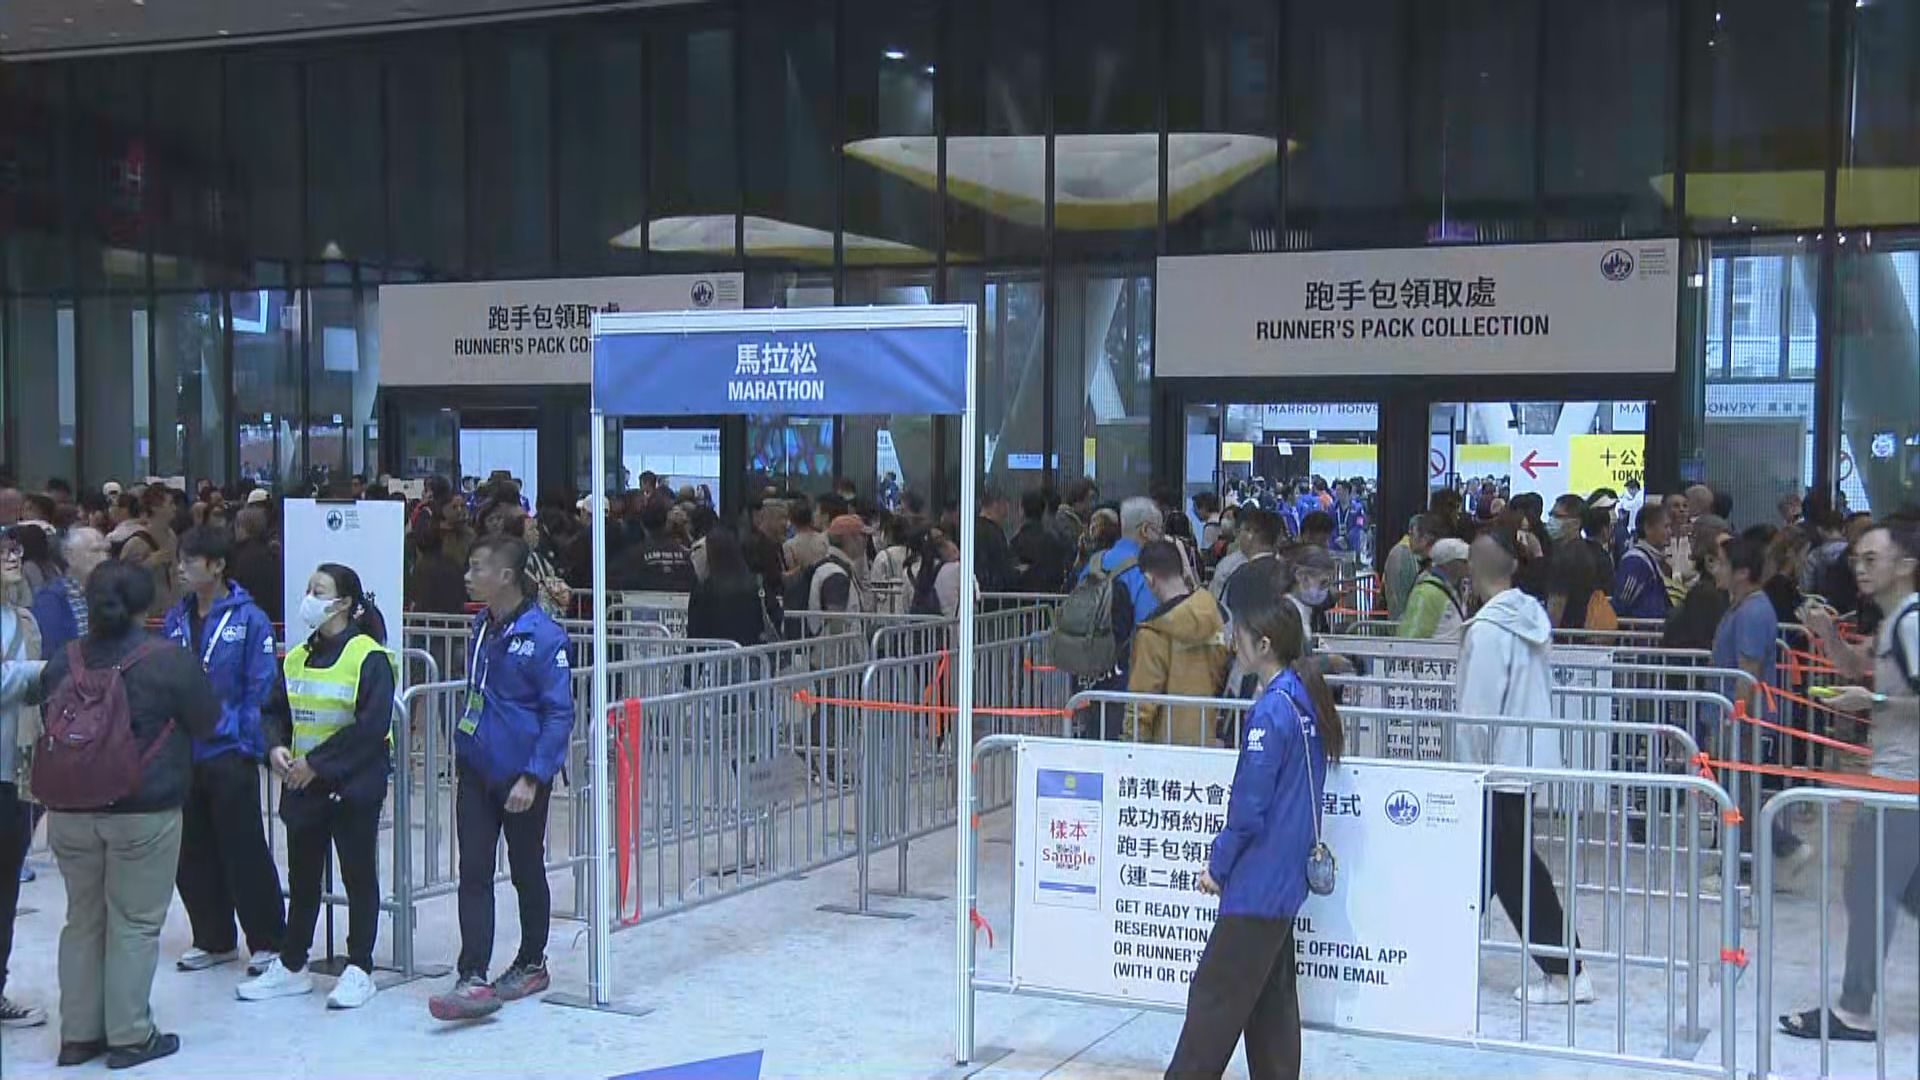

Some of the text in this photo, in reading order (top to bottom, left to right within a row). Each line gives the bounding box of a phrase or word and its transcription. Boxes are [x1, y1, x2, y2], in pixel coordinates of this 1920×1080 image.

[1305, 277, 1496, 311] 跑手包領取處
[488, 301, 620, 331] 跑手包領取
[1256, 314, 1550, 341] RUNNER'S PACK COLLECTION
[454, 336, 591, 356] RUNNER'S PACK CO
[735, 341, 818, 376] 馬拉松
[728, 380, 824, 401] MARATHON
[1612, 469, 1645, 482] 10KM
[1118, 776, 1232, 805] 請準備大會
[1050, 819, 1087, 840] 樣本
[1118, 805, 1225, 835] 成功預約版
[1042, 847, 1096, 867] Sample
[1115, 898, 1139, 914] GET
[1145, 902, 1190, 919] READY
[1115, 917, 1316, 942] RESERVATION UL
[1113, 940, 1132, 956] OR
[1136, 943, 1204, 963] RUNNER'S
[1309, 940, 1373, 961] OFFICIAL
[1377, 948, 1408, 964] APP
[1113, 961, 1390, 985] (WITH QR CO CTION EMAIL
